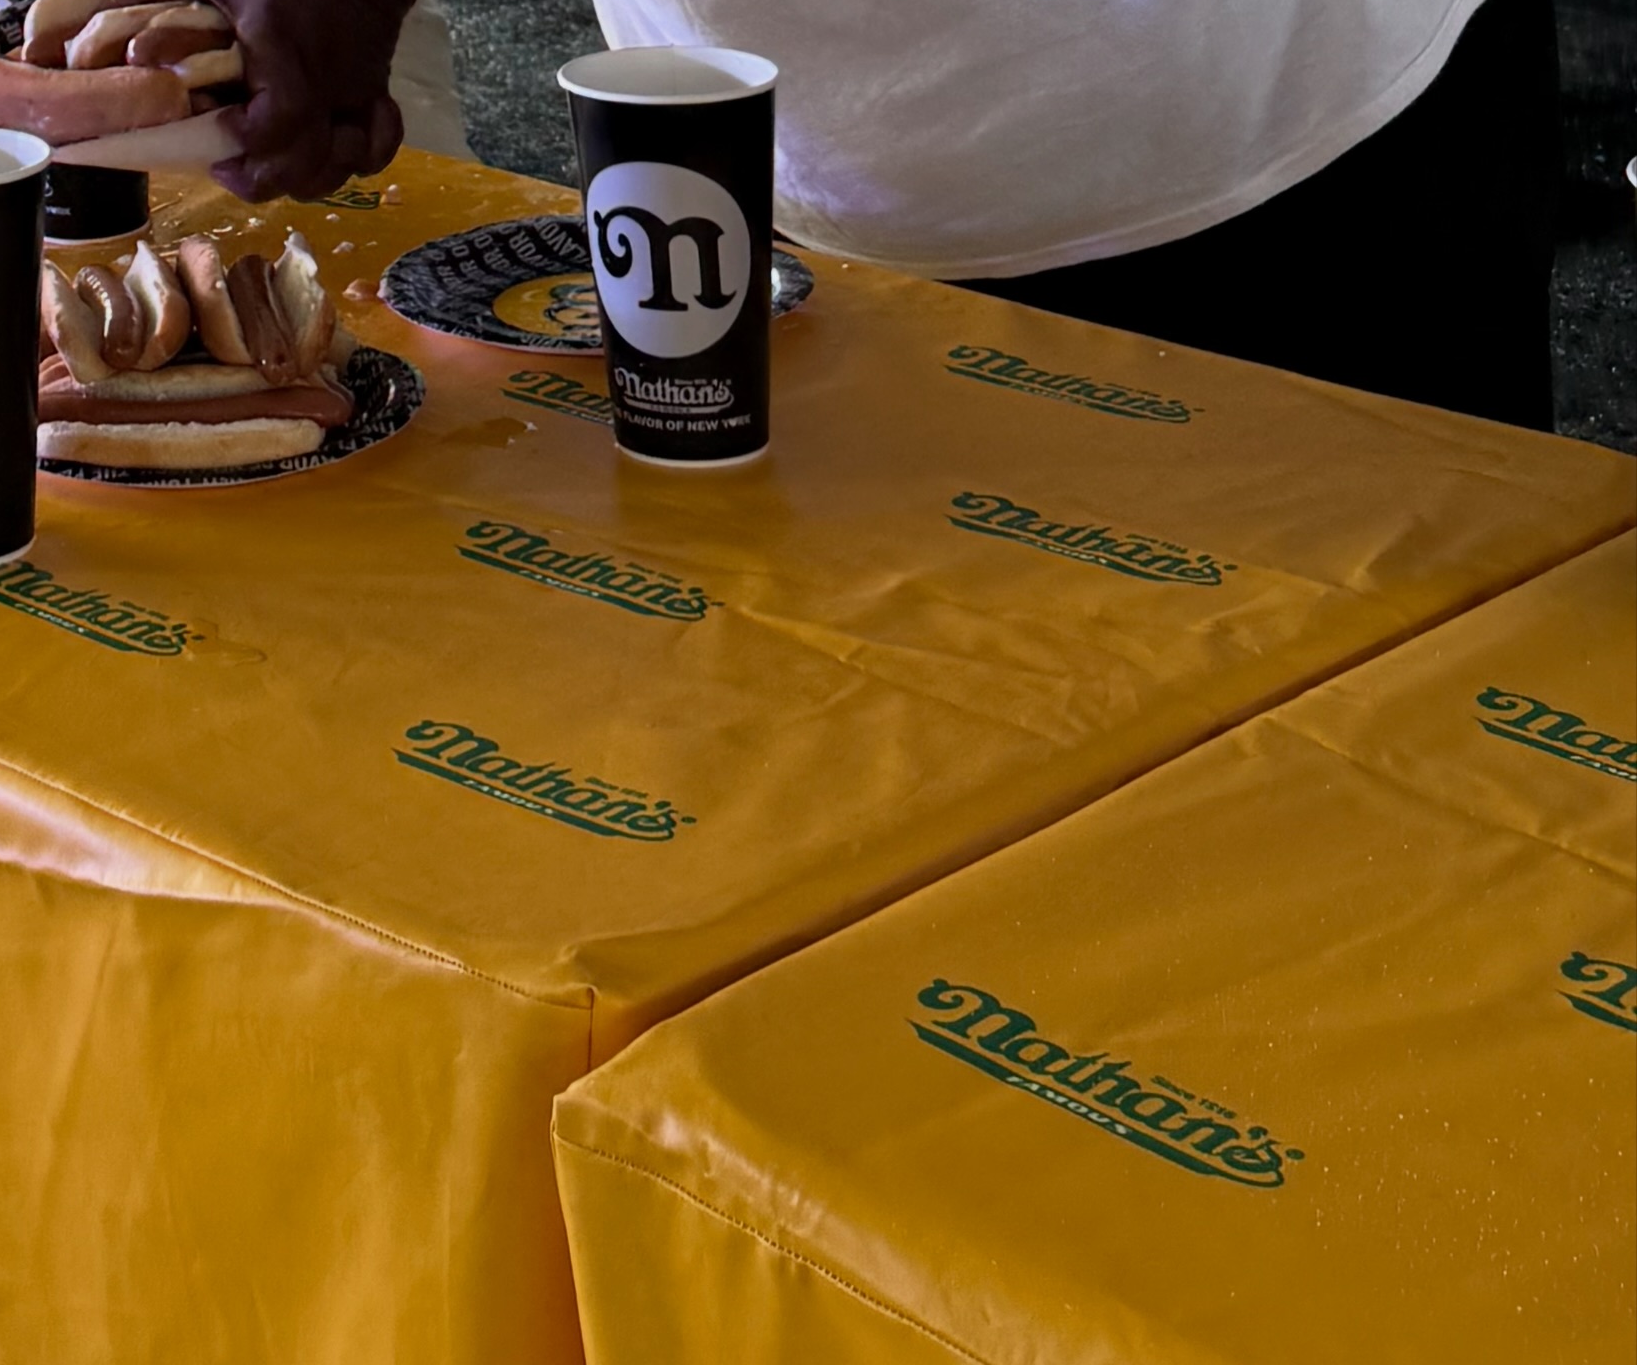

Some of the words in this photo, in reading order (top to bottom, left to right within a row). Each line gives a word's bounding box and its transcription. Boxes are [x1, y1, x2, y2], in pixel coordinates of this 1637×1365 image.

[614, 367, 735, 407] Nathan's
[665, 420, 684, 432] OF
[687, 420, 719, 432] NEW
[949, 344, 1194, 422] Nathan's
[466, 520, 710, 620] Nathan's
[952, 491, 1225, 586] Nathan's
[404, 718, 677, 841] Nathan's
[916, 978, 1284, 1188] Nathan's
[1006, 1074, 1129, 1135] FAMOUS
